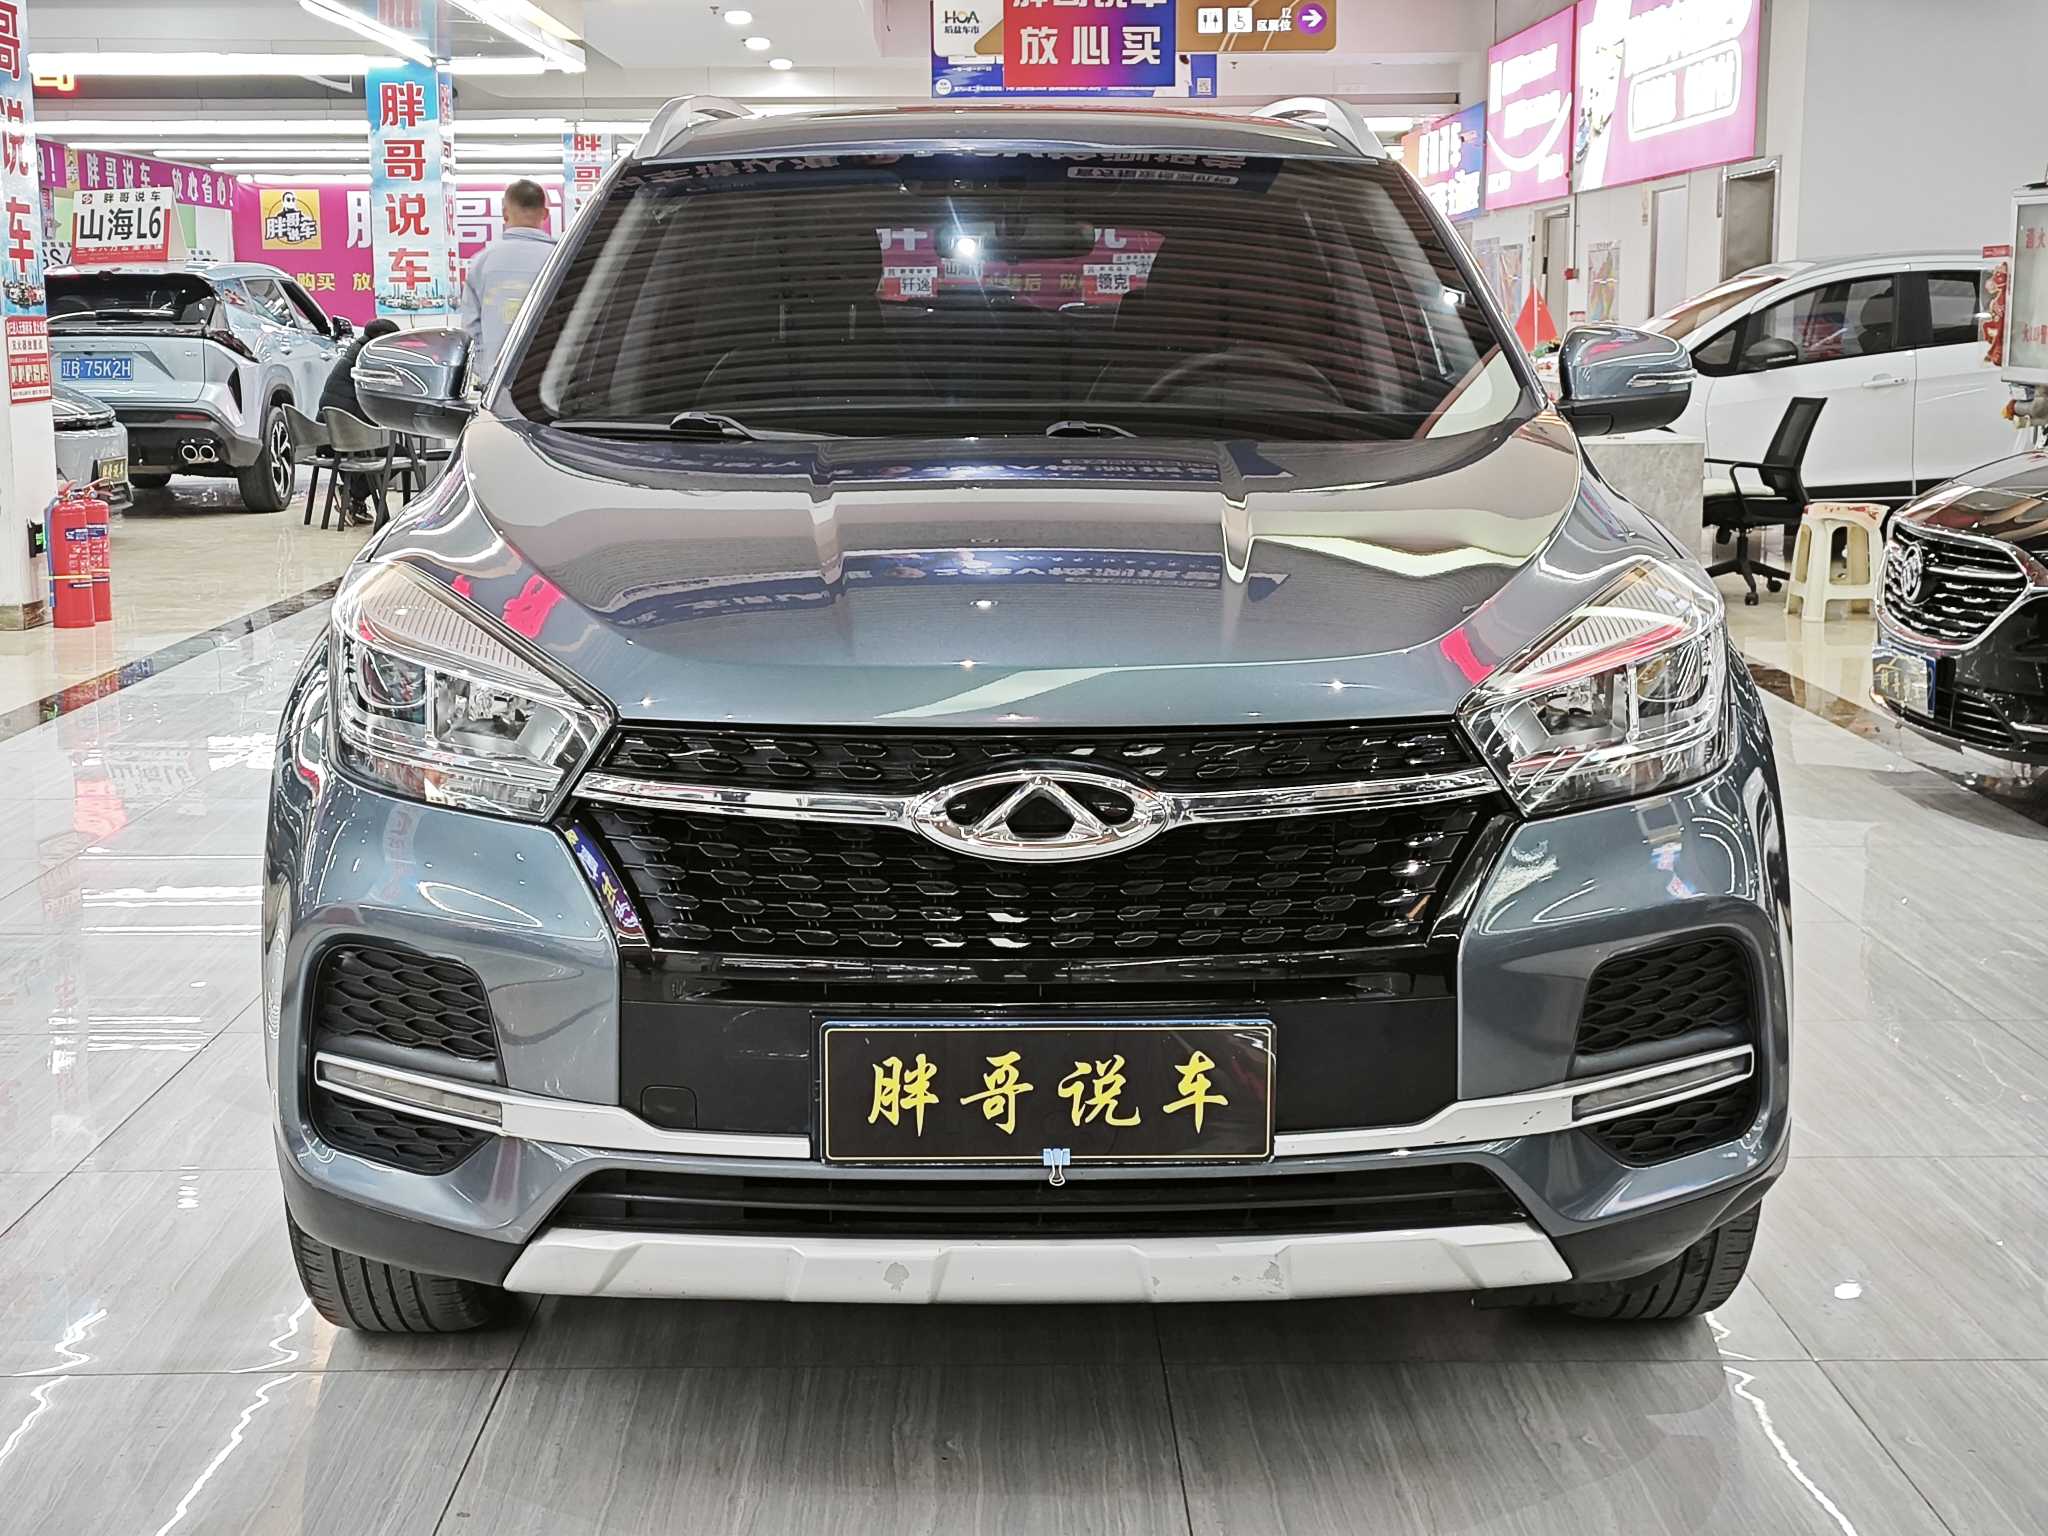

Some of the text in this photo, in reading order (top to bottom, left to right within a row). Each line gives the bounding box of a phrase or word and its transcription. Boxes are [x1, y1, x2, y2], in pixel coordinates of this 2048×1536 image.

[1019, 26, 1161, 65] 放心买
[380, 82, 431, 291] 胖哥说车
[79, 206, 161, 242] 山海L6
[353, 273, 374, 291] 放
[867, 1050, 1229, 1136] 胖哥说车
